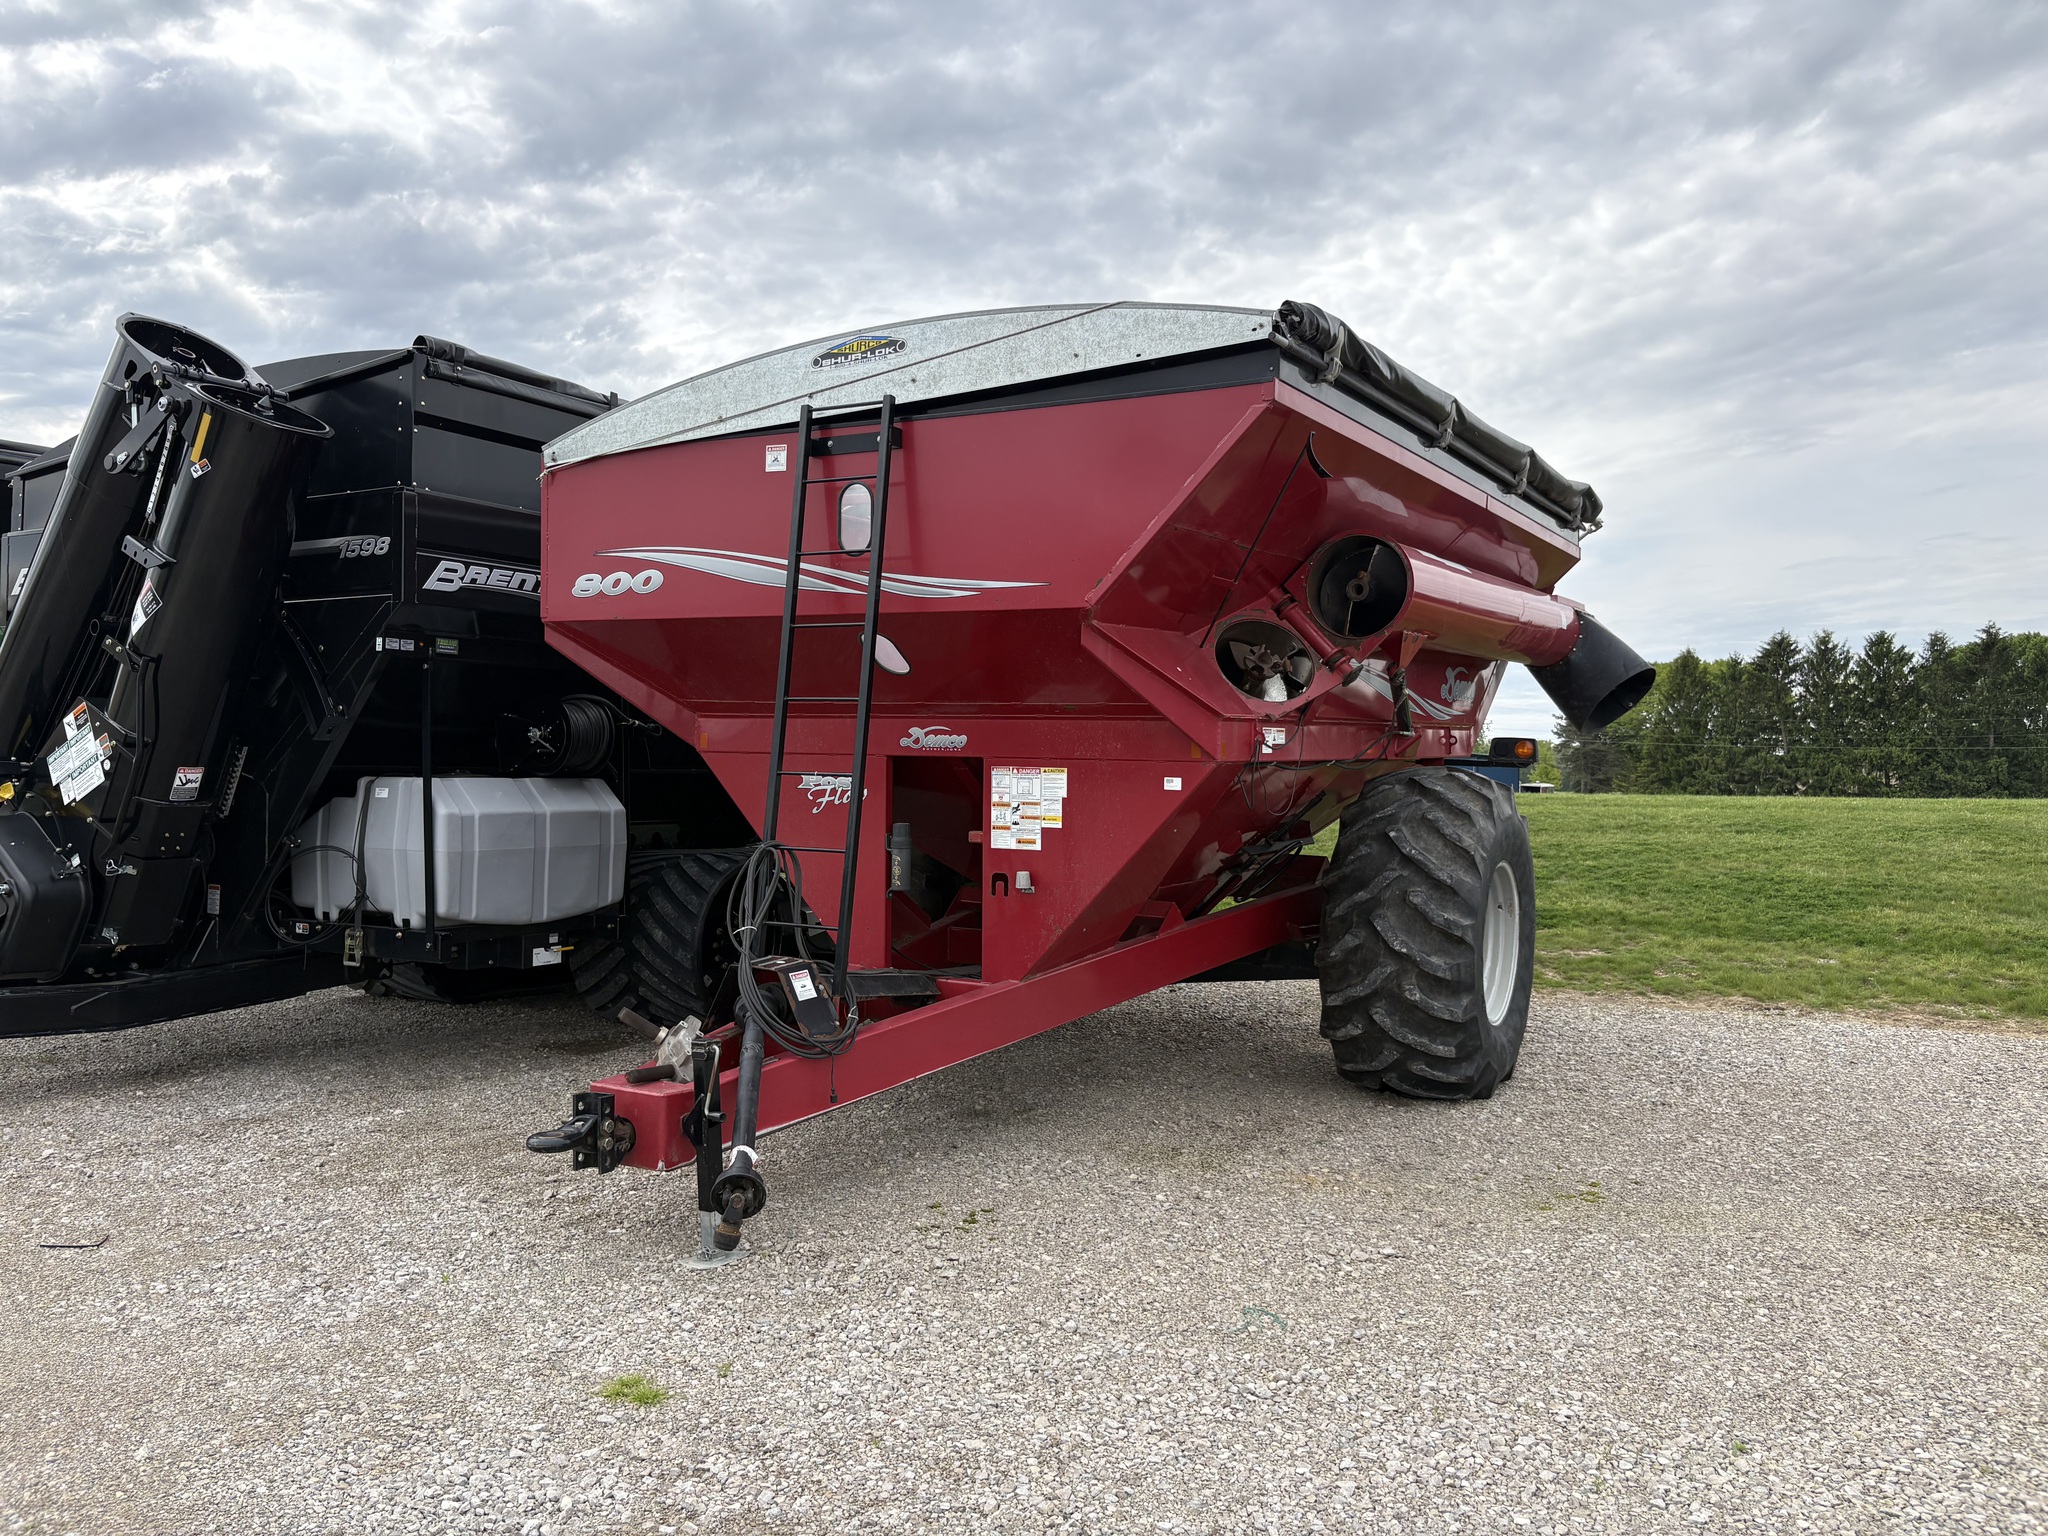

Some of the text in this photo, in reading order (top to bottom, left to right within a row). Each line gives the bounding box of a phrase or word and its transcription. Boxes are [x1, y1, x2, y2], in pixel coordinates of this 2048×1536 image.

[822, 346, 896, 367] SHUR-LOK
[340, 537, 391, 559] 1598
[422, 560, 541, 593] BREN
[572, 569, 664, 598] 800
[900, 726, 968, 749] Demco
[71, 753, 100, 780] IMPORTANT
[797, 775, 853, 790] Pos
